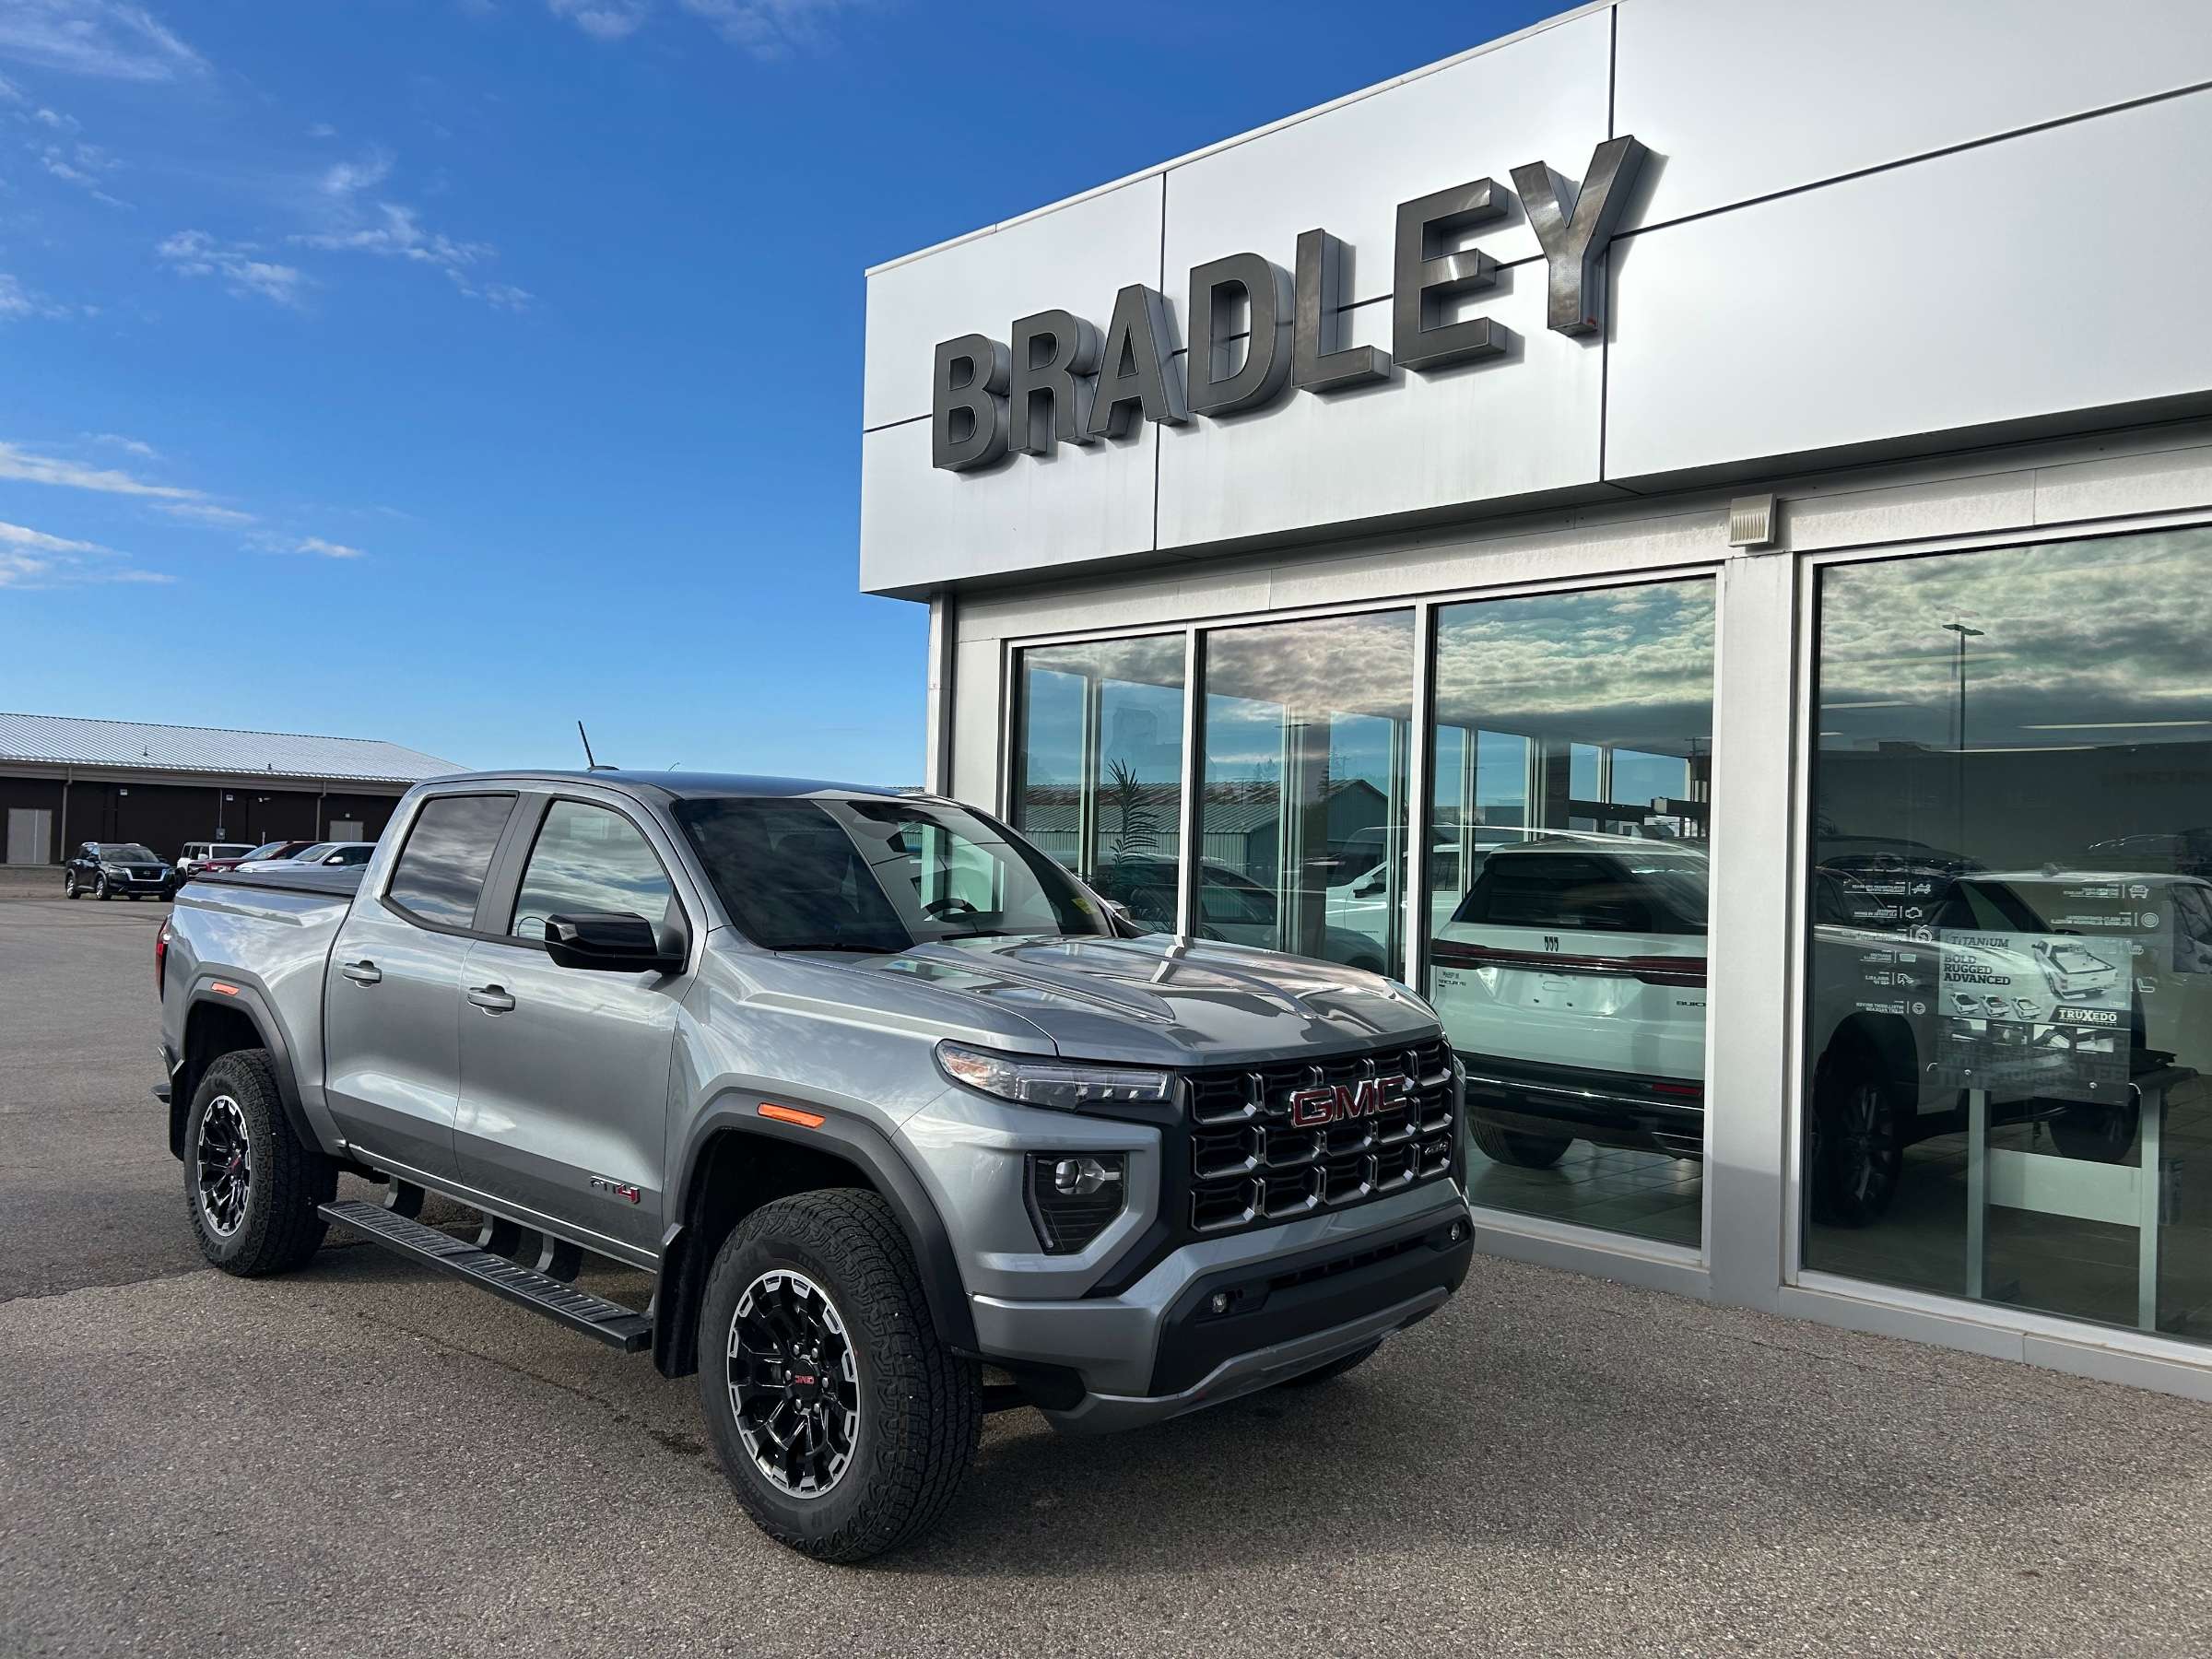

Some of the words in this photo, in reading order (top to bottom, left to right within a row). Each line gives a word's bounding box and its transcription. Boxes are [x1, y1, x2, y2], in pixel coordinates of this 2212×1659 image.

[933, 134, 1650, 472] BRADLEY
[1944, 953, 1977, 964] BOLD
[1943, 963, 1993, 975] RUGGED
[1943, 972, 2011, 985] ADVANCED
[2058, 1009, 2117, 1022] TRUXEDO
[1289, 1074, 1407, 1129] GMC
